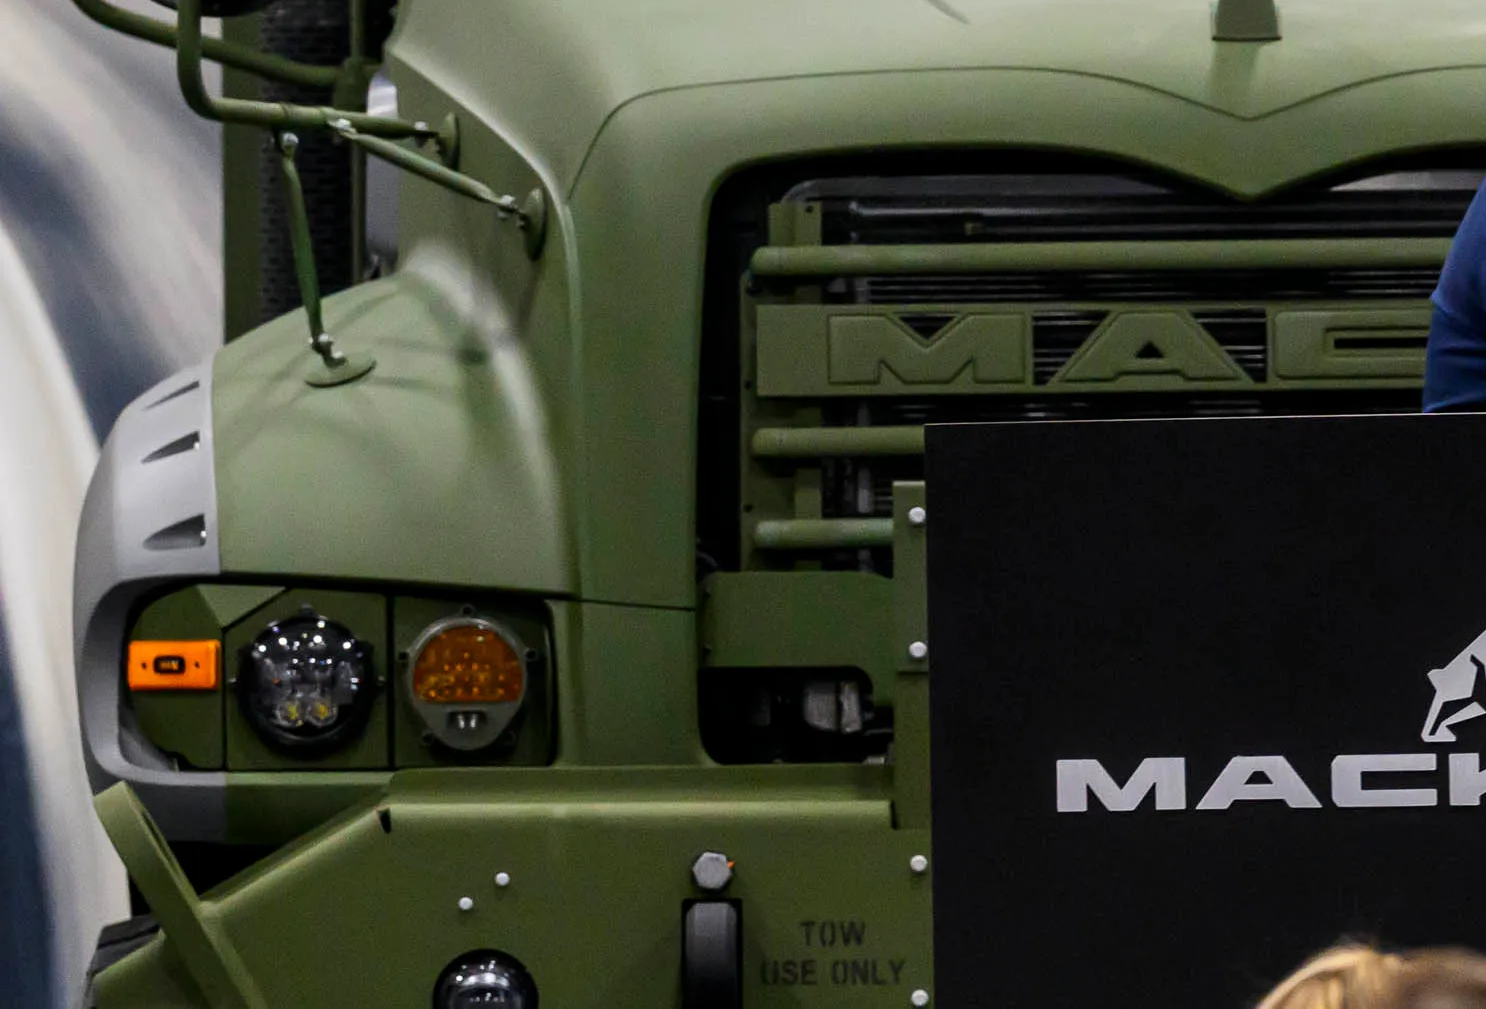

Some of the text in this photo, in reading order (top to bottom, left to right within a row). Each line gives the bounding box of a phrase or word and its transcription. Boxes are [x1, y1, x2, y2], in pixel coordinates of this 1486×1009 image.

[828, 308, 1428, 385] MAC
[801, 919, 867, 948] TOW
[760, 958, 906, 986] USE ONLY
